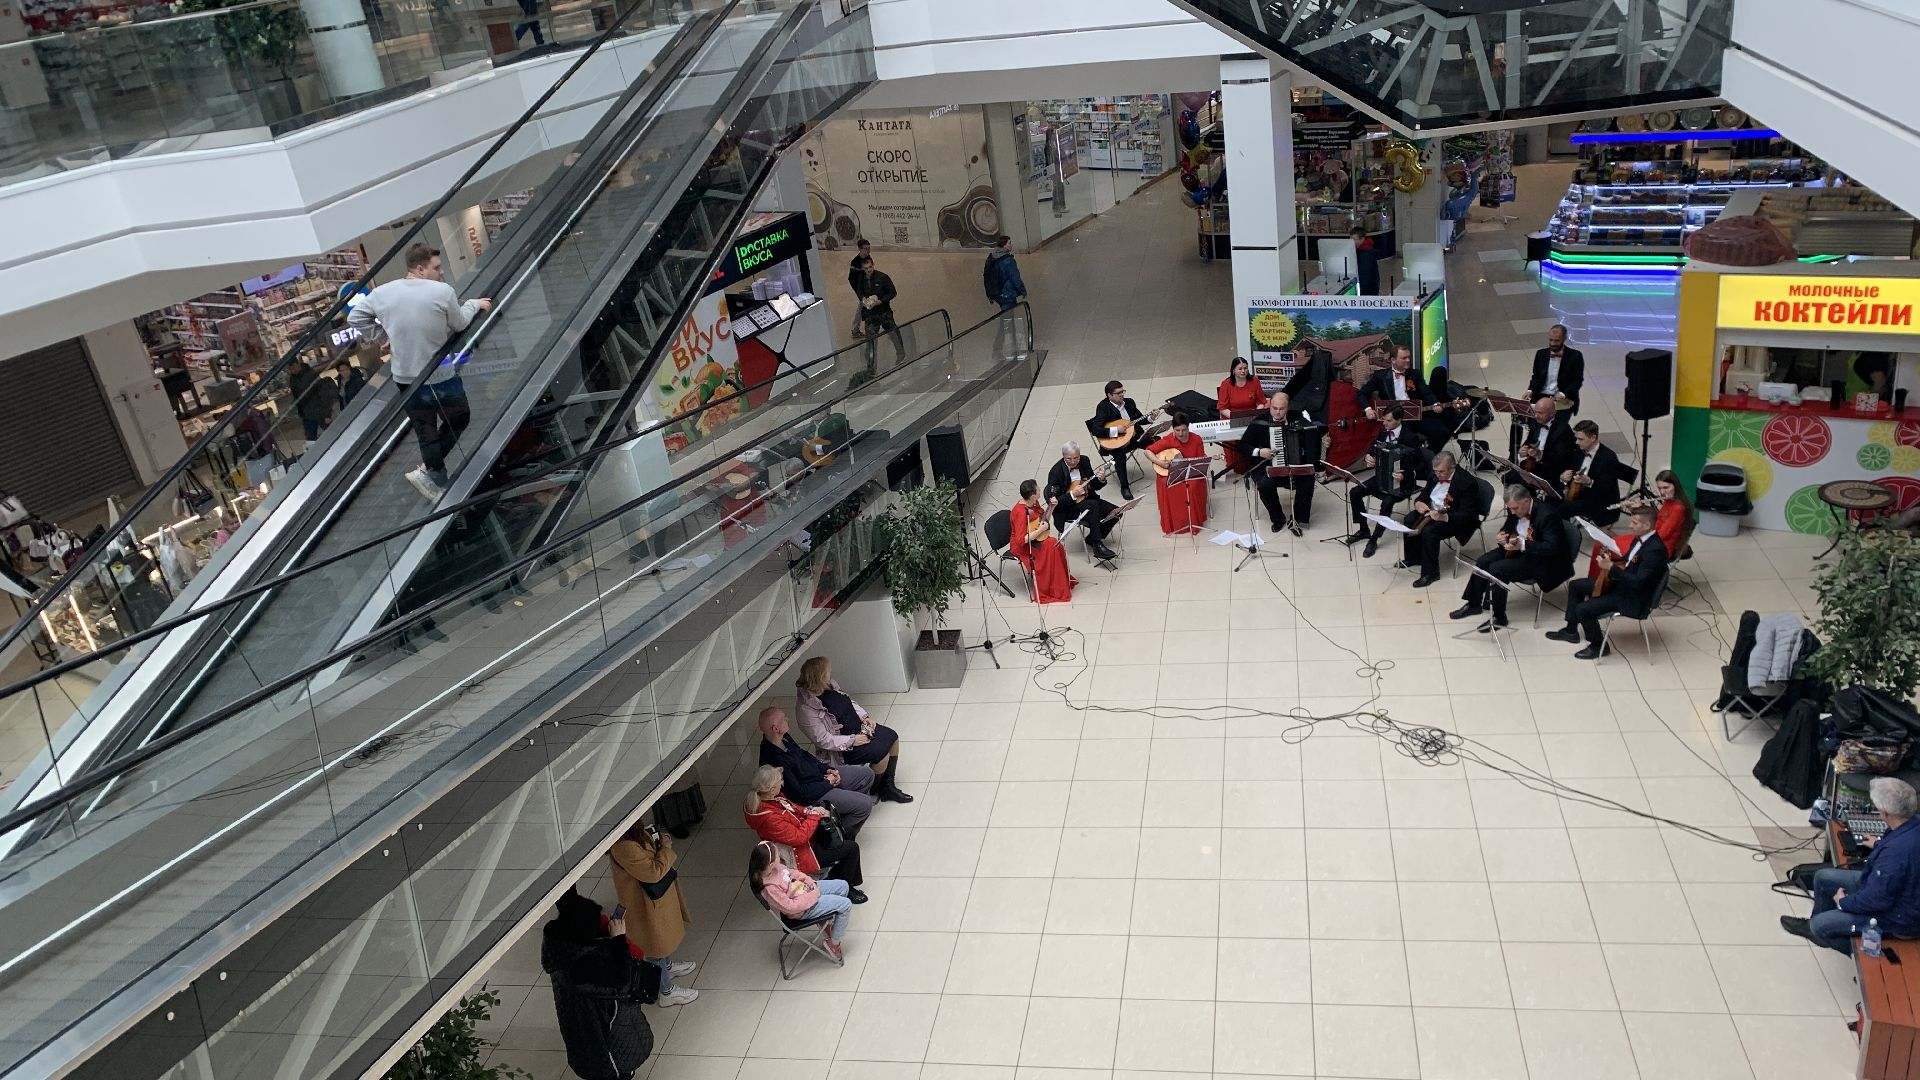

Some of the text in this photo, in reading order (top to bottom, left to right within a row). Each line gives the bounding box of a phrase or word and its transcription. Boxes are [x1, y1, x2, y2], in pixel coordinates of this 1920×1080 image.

[867, 149, 911, 163] СКОРО
[858, 169, 929, 183] ОТКРЫТИЕ
[740, 229, 790, 257] ДОСТАВКА
[743, 248, 773, 270] ВКУСА
[1252, 299, 1319, 308] КОМФОРТНЫЕ
[1320, 299, 1348, 308] ДОМА
[1350, 299, 1357, 308] В
